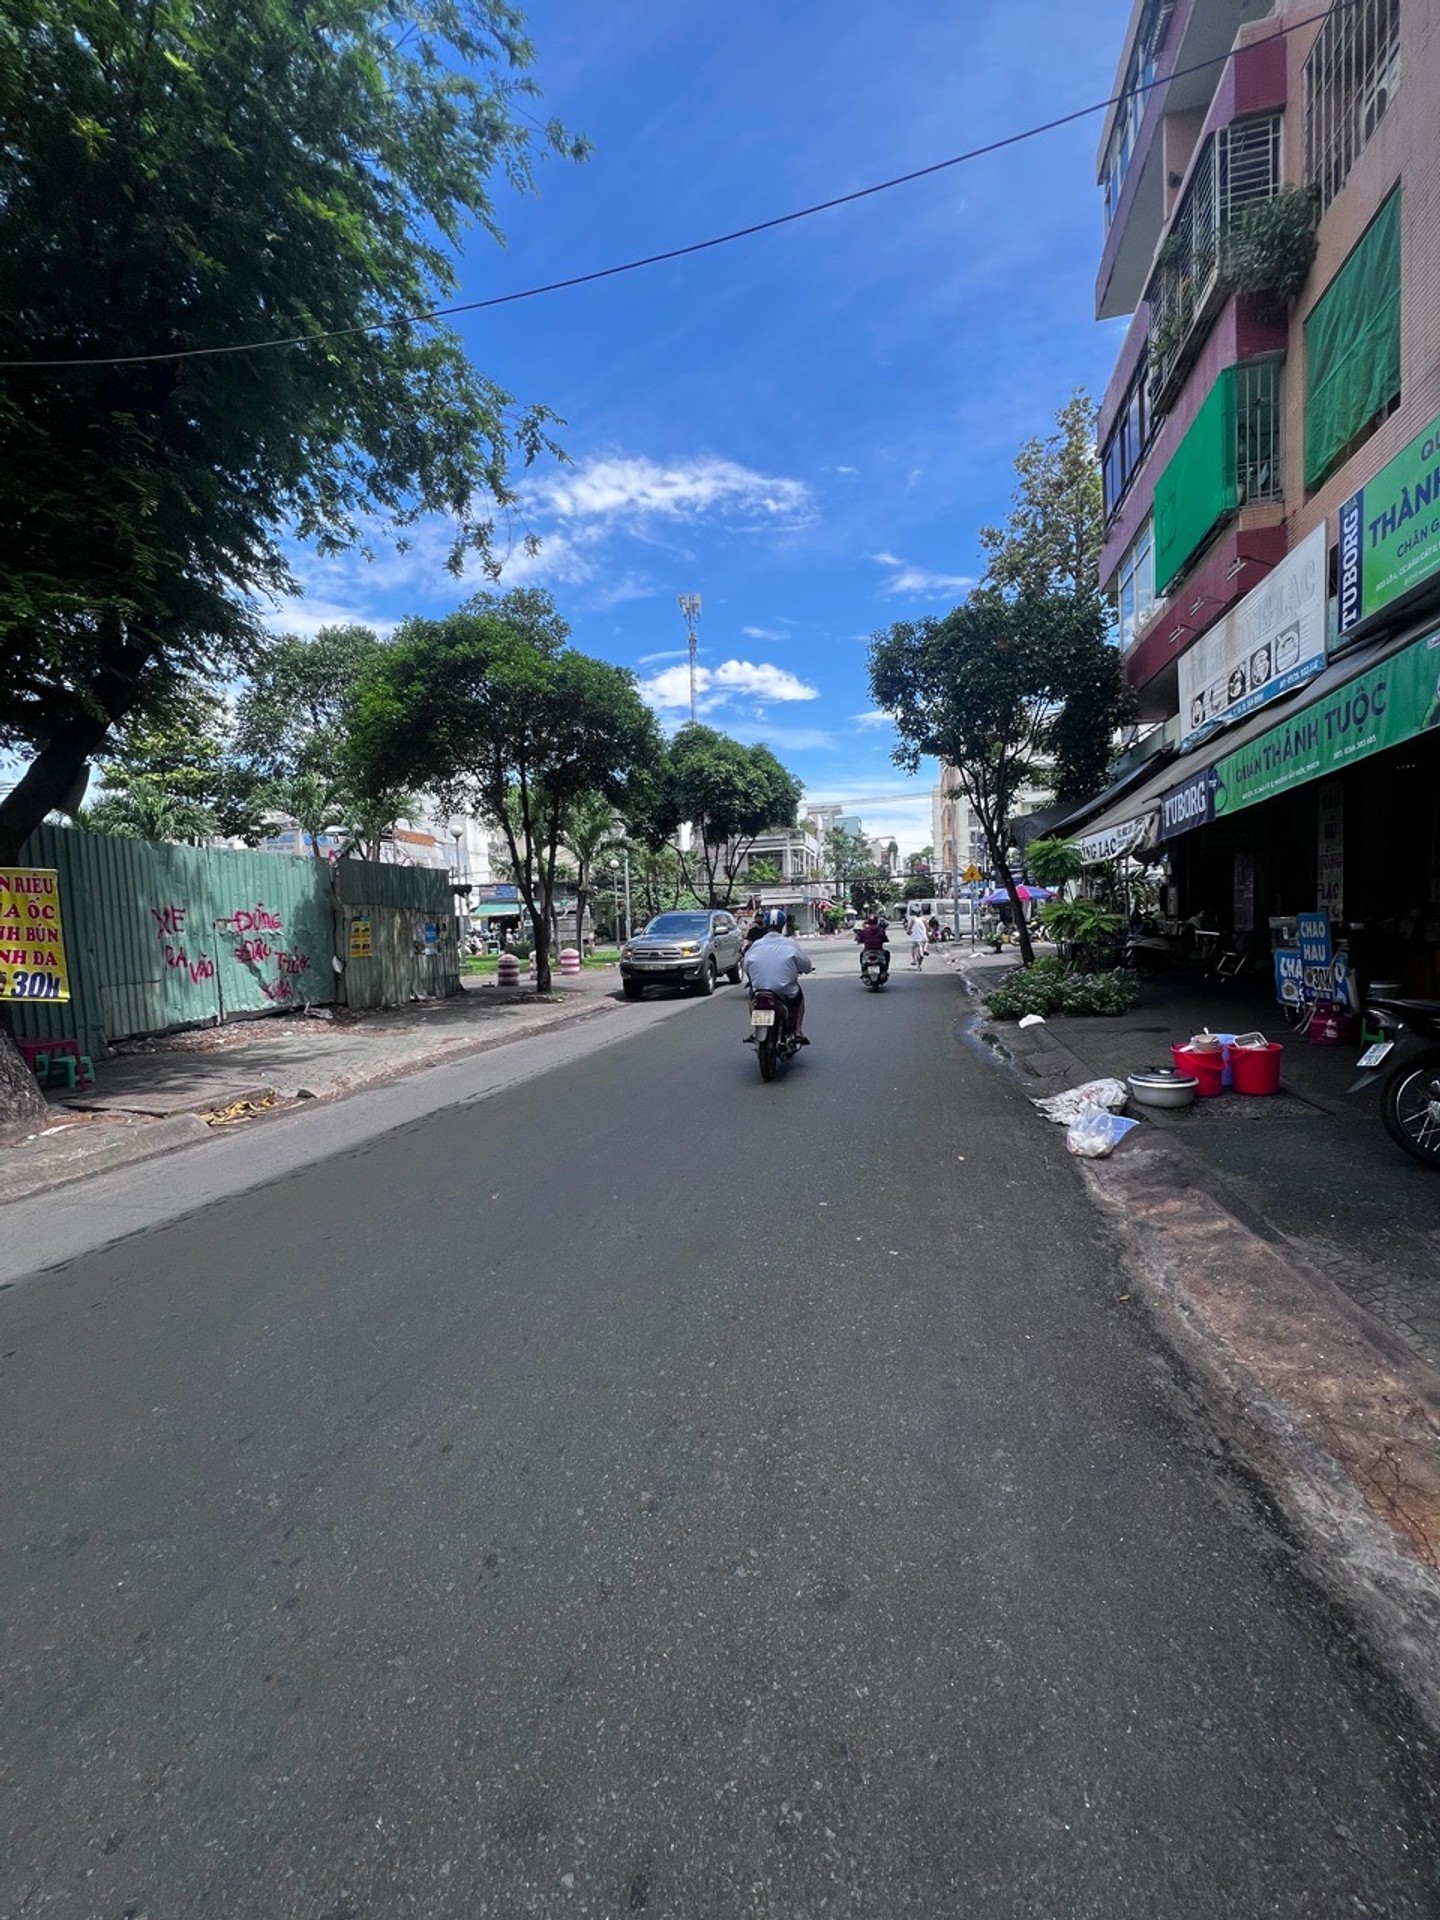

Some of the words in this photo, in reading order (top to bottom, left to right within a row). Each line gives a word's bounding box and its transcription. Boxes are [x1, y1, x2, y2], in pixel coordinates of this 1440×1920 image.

[1342, 509, 1359, 630] TUBORG
[1263, 718, 1320, 770] THÀNH
[1325, 681, 1387, 740] TUỘC
[1165, 781, 1206, 828] TUBORG
[15, 873, 54, 894] RIÊU
[27, 897, 55, 919] ỐC
[151, 904, 186, 939] XE
[26, 923, 58, 942] BÚN
[33, 950, 58, 967] ĐA
